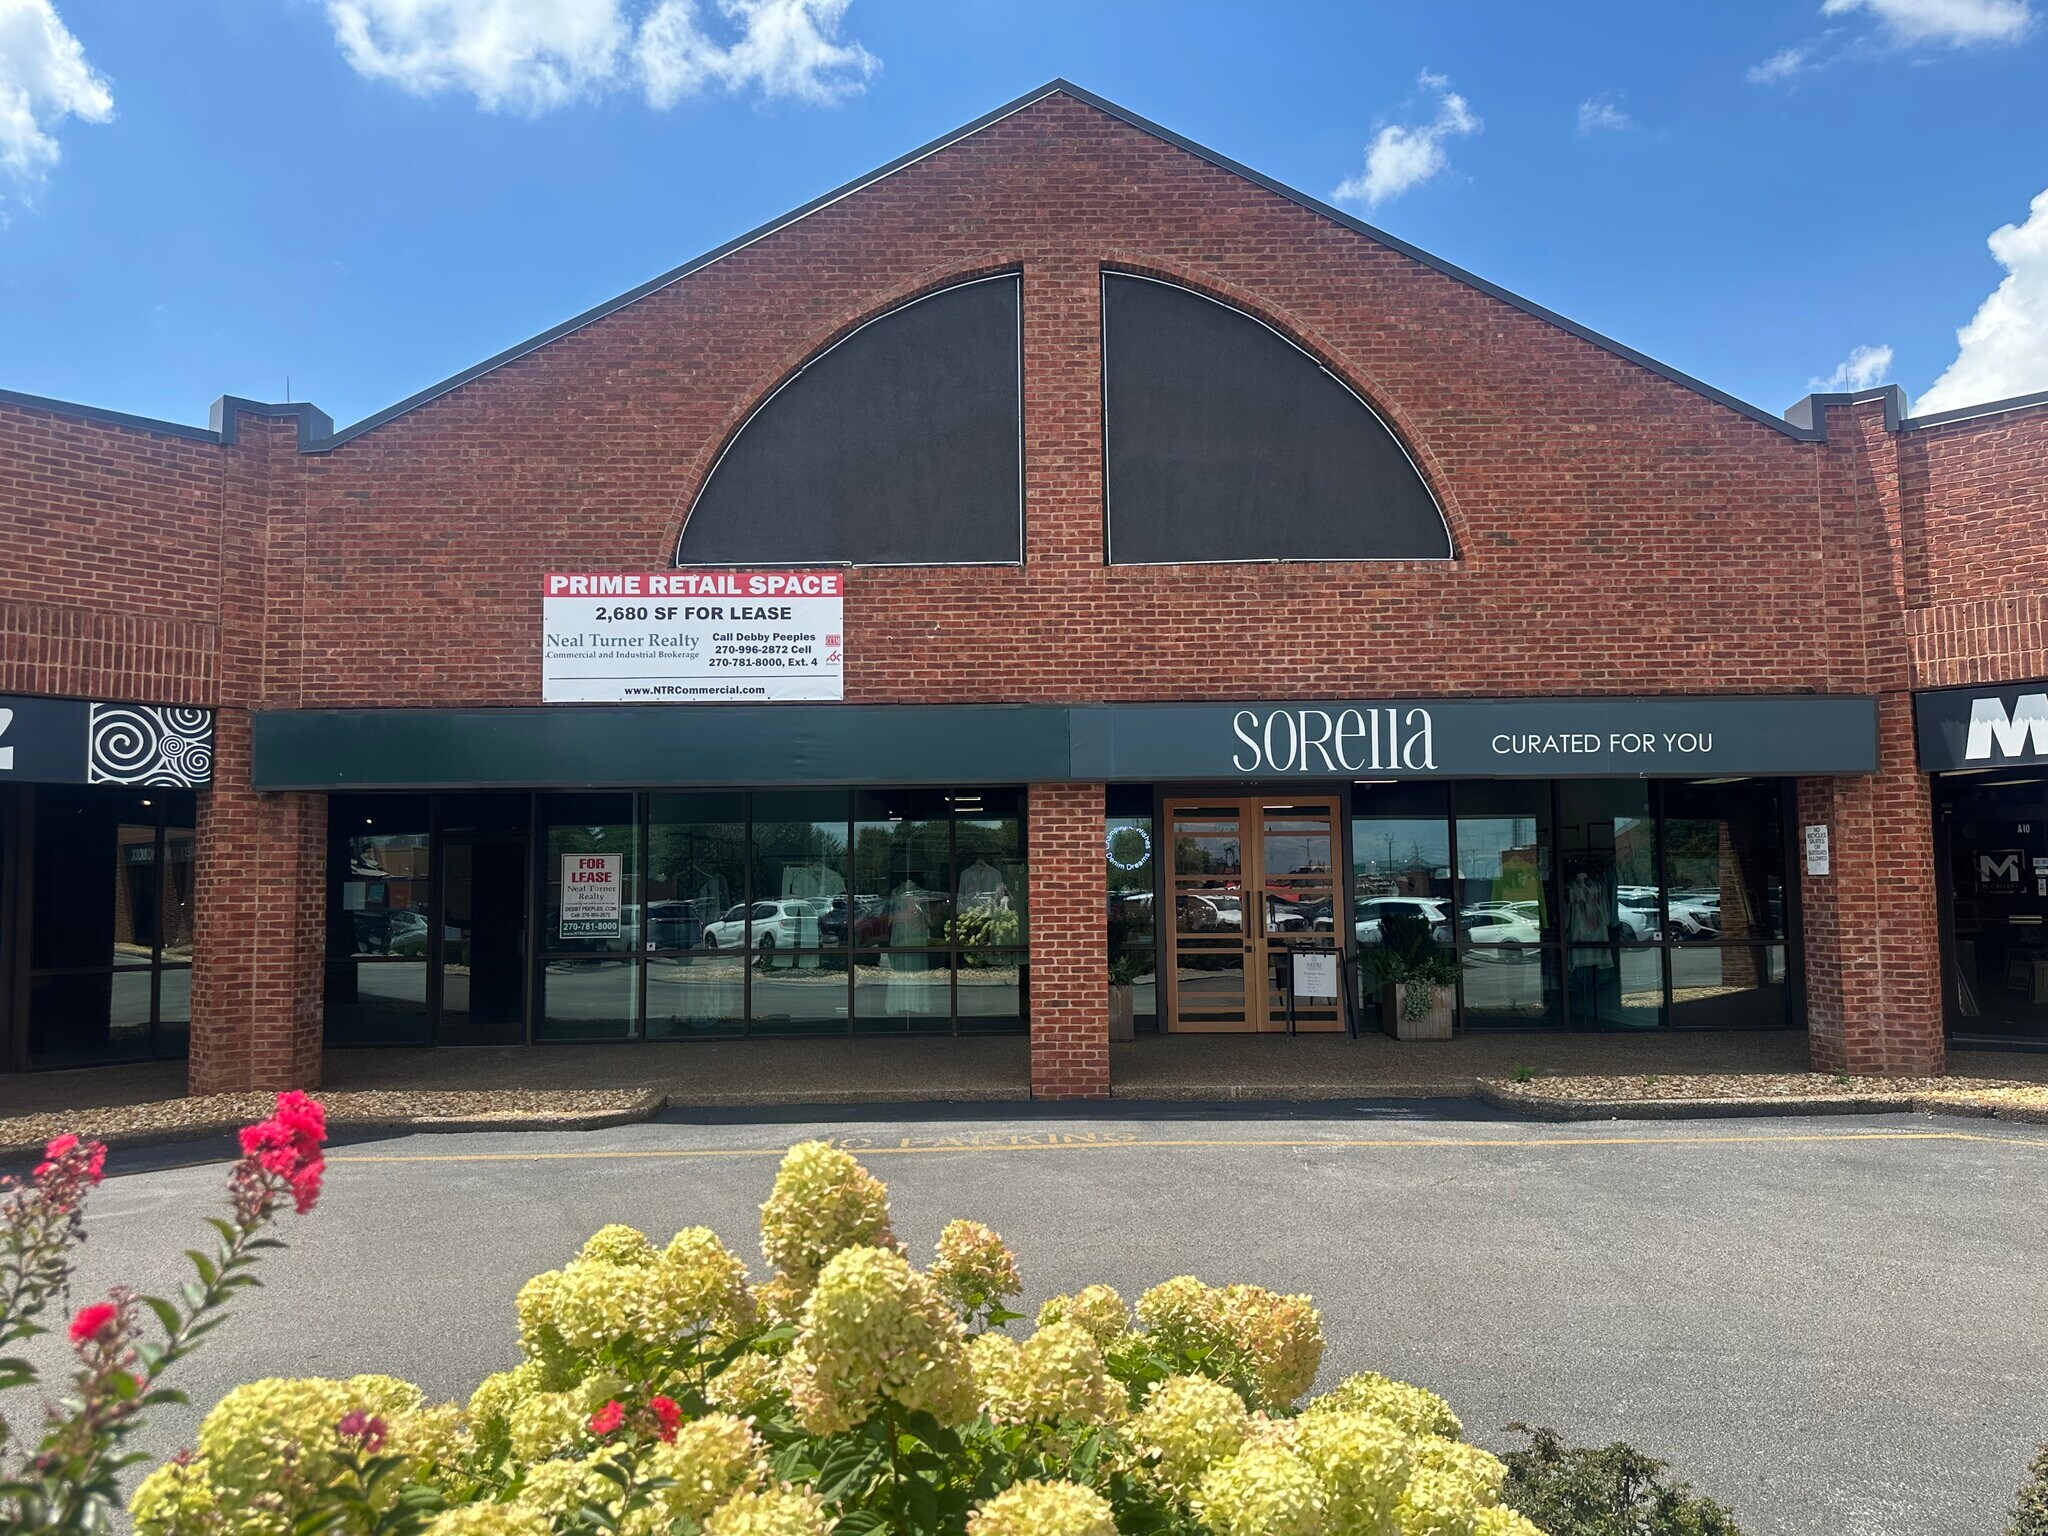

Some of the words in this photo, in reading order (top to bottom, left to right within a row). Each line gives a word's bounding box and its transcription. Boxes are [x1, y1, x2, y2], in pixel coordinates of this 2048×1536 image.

[550, 575, 641, 595] PRIME
[649, 575, 742, 595] RETAIL
[748, 575, 837, 595] SPACE
[595, 607, 648, 623] 2,680
[654, 607, 678, 621] SF
[684, 607, 724, 620] FOR
[730, 607, 792, 620] LEASE
[546, 633, 584, 647] Neal
[588, 633, 645, 647] Turner
[648, 633, 700, 651] Realty
[712, 633, 733, 641] Call
[736, 633, 770, 643] Debby
[772, 633, 816, 643] Peeples
[715, 645, 789, 654] 270-996-2872
[791, 645, 812, 653] Cell
[547, 651, 596, 659] Commercial
[658, 651, 700, 660] Brokerage
[709, 658, 785, 667] 270-781-8000,
[788, 658, 808, 666] Ext.
[811, 657, 818, 666] 4
[624, 686, 765, 695] www.NTRCommercial.com
[1965, 693, 2048, 760] M
[1491, 734, 1601, 755] CURATED
[1610, 734, 1655, 753] FOR
[1662, 733, 1713, 753] YOU
[2017, 824, 2030, 833] A10
[579, 859, 605, 869] FOR
[1106, 852, 1125, 869] Denim
[1126, 852, 1151, 870] Dreams
[571, 872, 612, 883] LEASE
[579, 893, 604, 901] Realty
[563, 922, 617, 931] 270-781-8000
